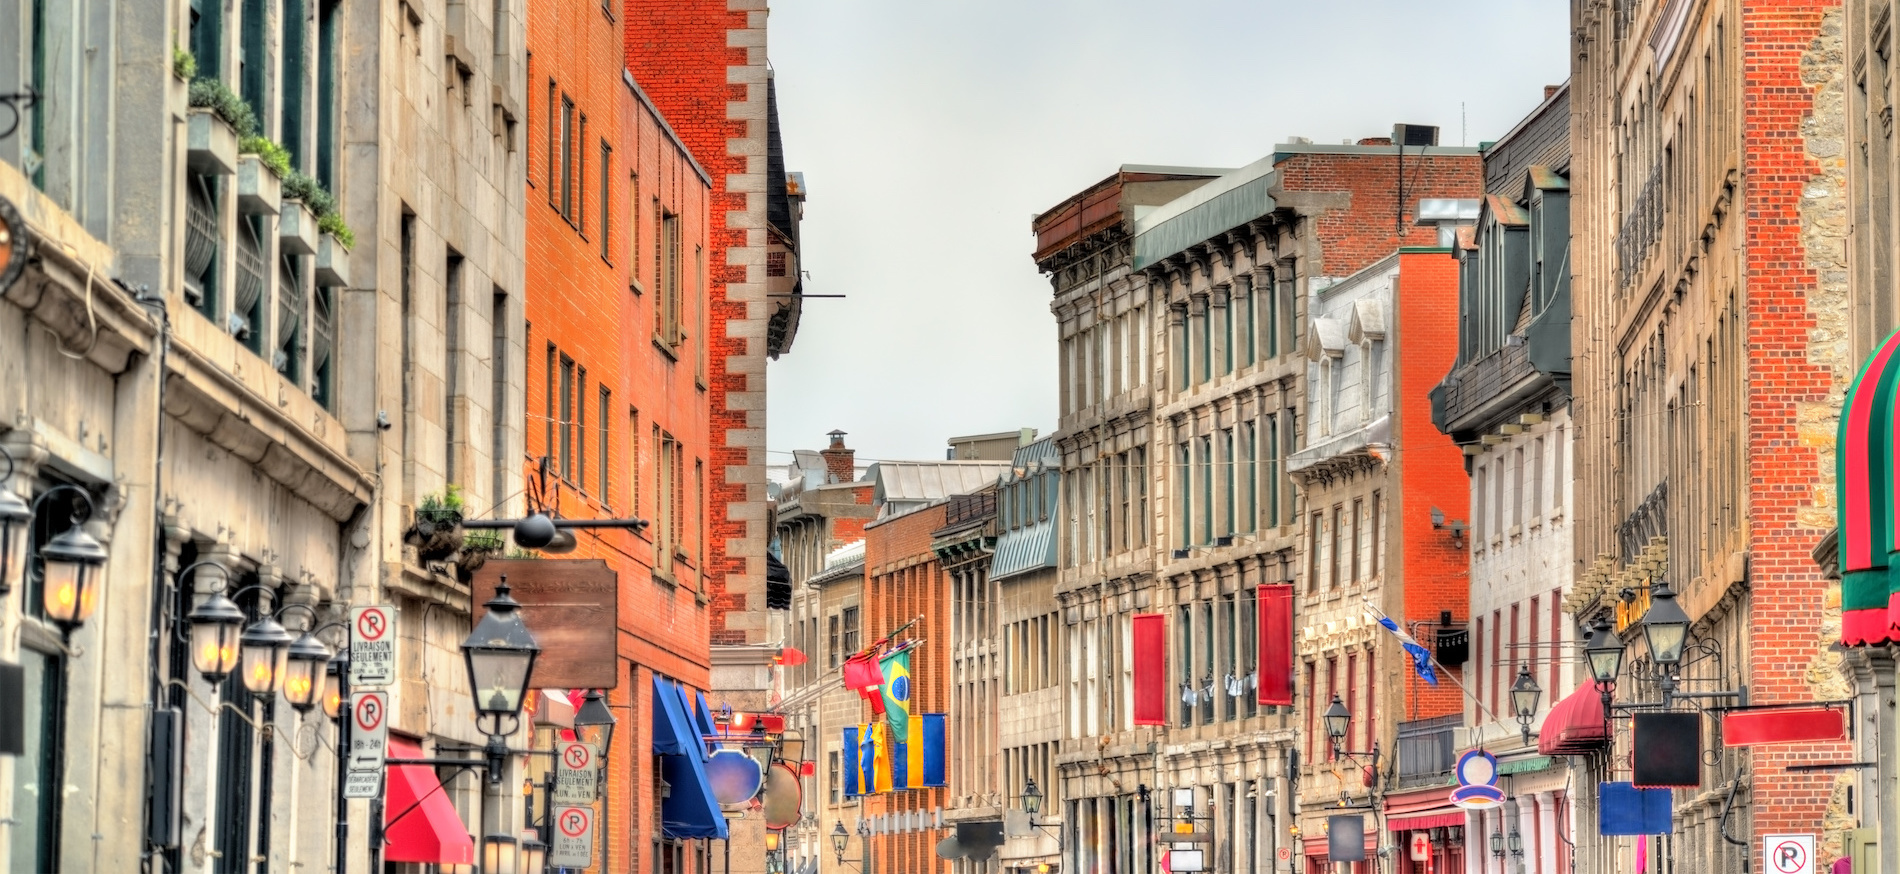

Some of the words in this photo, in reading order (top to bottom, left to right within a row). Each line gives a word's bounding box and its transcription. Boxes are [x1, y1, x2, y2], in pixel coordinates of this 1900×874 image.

[368, 615, 378, 632] P
[353, 641, 391, 652] LIVRAISON
[351, 651, 392, 662] SEULEMENT
[365, 703, 375, 722] P
[354, 739, 364, 750] 18h
[369, 739, 381, 750] 24h
[574, 750, 582, 762] P
[559, 769, 592, 778] LIVRAISON
[556, 777, 593, 786] SEULEMENT
[349, 785, 374, 793] SEULEMENT
[570, 816, 579, 830] P
[1782, 847, 1798, 867] P
